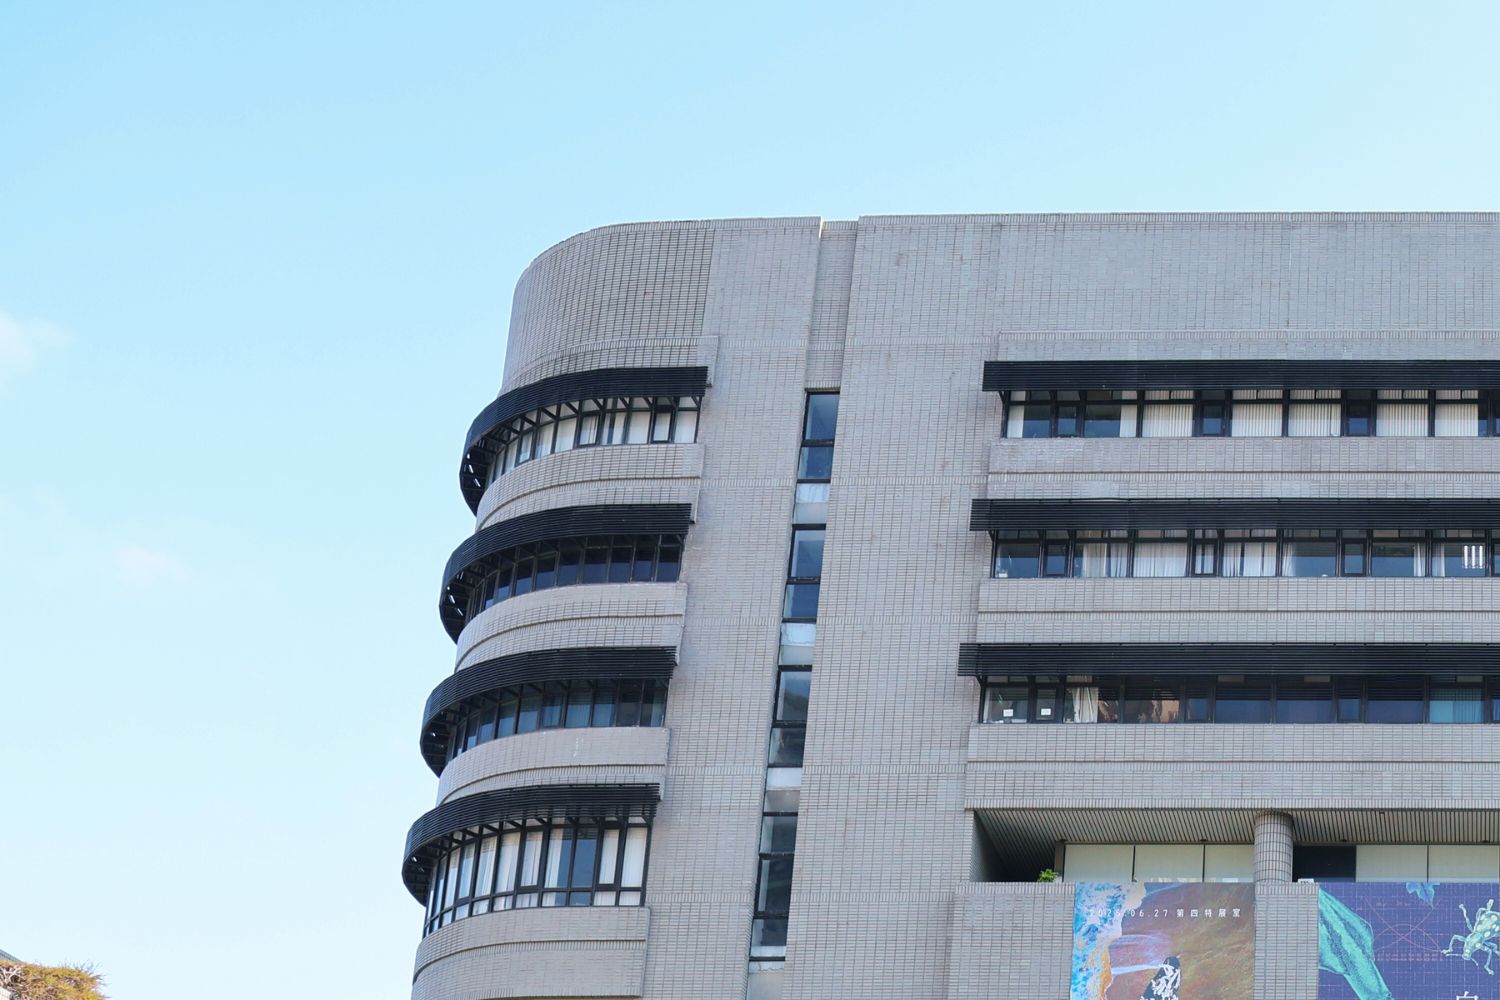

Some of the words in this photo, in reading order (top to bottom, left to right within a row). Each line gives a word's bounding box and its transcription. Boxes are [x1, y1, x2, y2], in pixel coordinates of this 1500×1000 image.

[1176, 908, 1241, 918] 第四特展室
